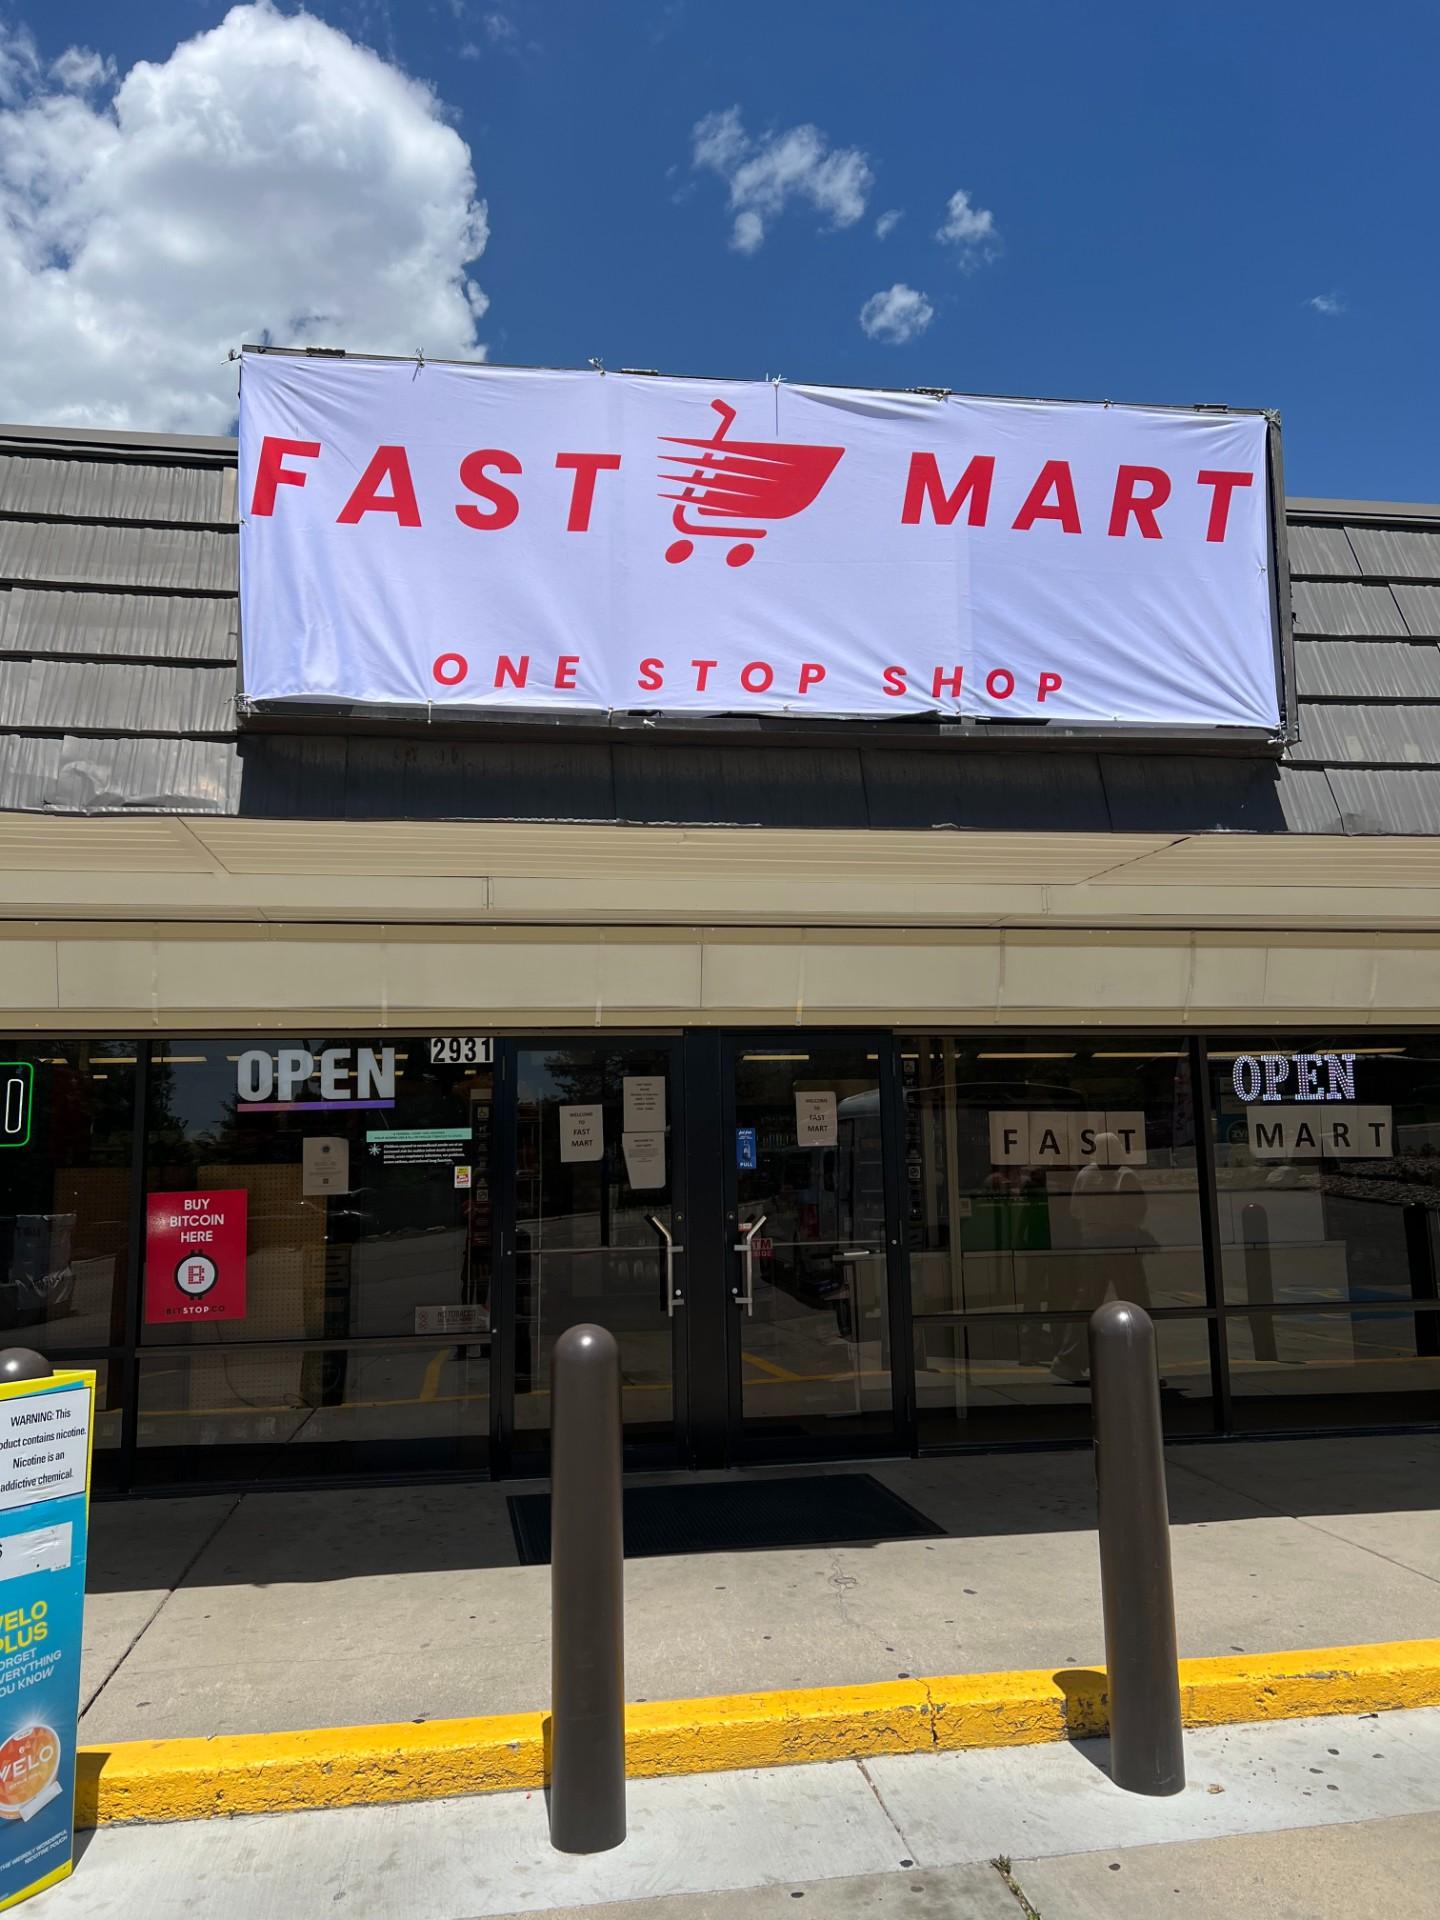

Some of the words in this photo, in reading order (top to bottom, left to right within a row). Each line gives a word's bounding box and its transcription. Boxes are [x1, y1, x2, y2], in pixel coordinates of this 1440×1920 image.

[251, 435, 622, 533] FAST
[901, 452, 1254, 543] MART
[432, 652, 580, 689] ONE
[637, 658, 826, 694] STOP
[883, 665, 1063, 703] SHOP
[432, 1038, 493, 1063] 2931
[237, 1047, 396, 1103] OPEN
[1233, 1054, 1356, 1103] OPEN
[571, 1139, 593, 1147] MART
[1004, 1128, 1136, 1155] FAST
[1256, 1122, 1386, 1149] MART
[184, 1198, 211, 1211] BUY
[169, 1213, 225, 1227] BITCOIN
[180, 1230, 214, 1243] HERE
[751, 1239, 771, 1249] TM
[10, 1411, 54, 1427] WARNING:
[55, 1407, 71, 1420] This
[22, 1432, 55, 1446] contains
[56, 1426, 86, 1440] nicotine.
[13, 1454, 46, 1469] Nicotine
[47, 1451, 54, 1462] is
[55, 1451, 65, 1460] an
[0, 1476, 37, 1492] addictive
[18, 1665, 55, 1690] KNOW
